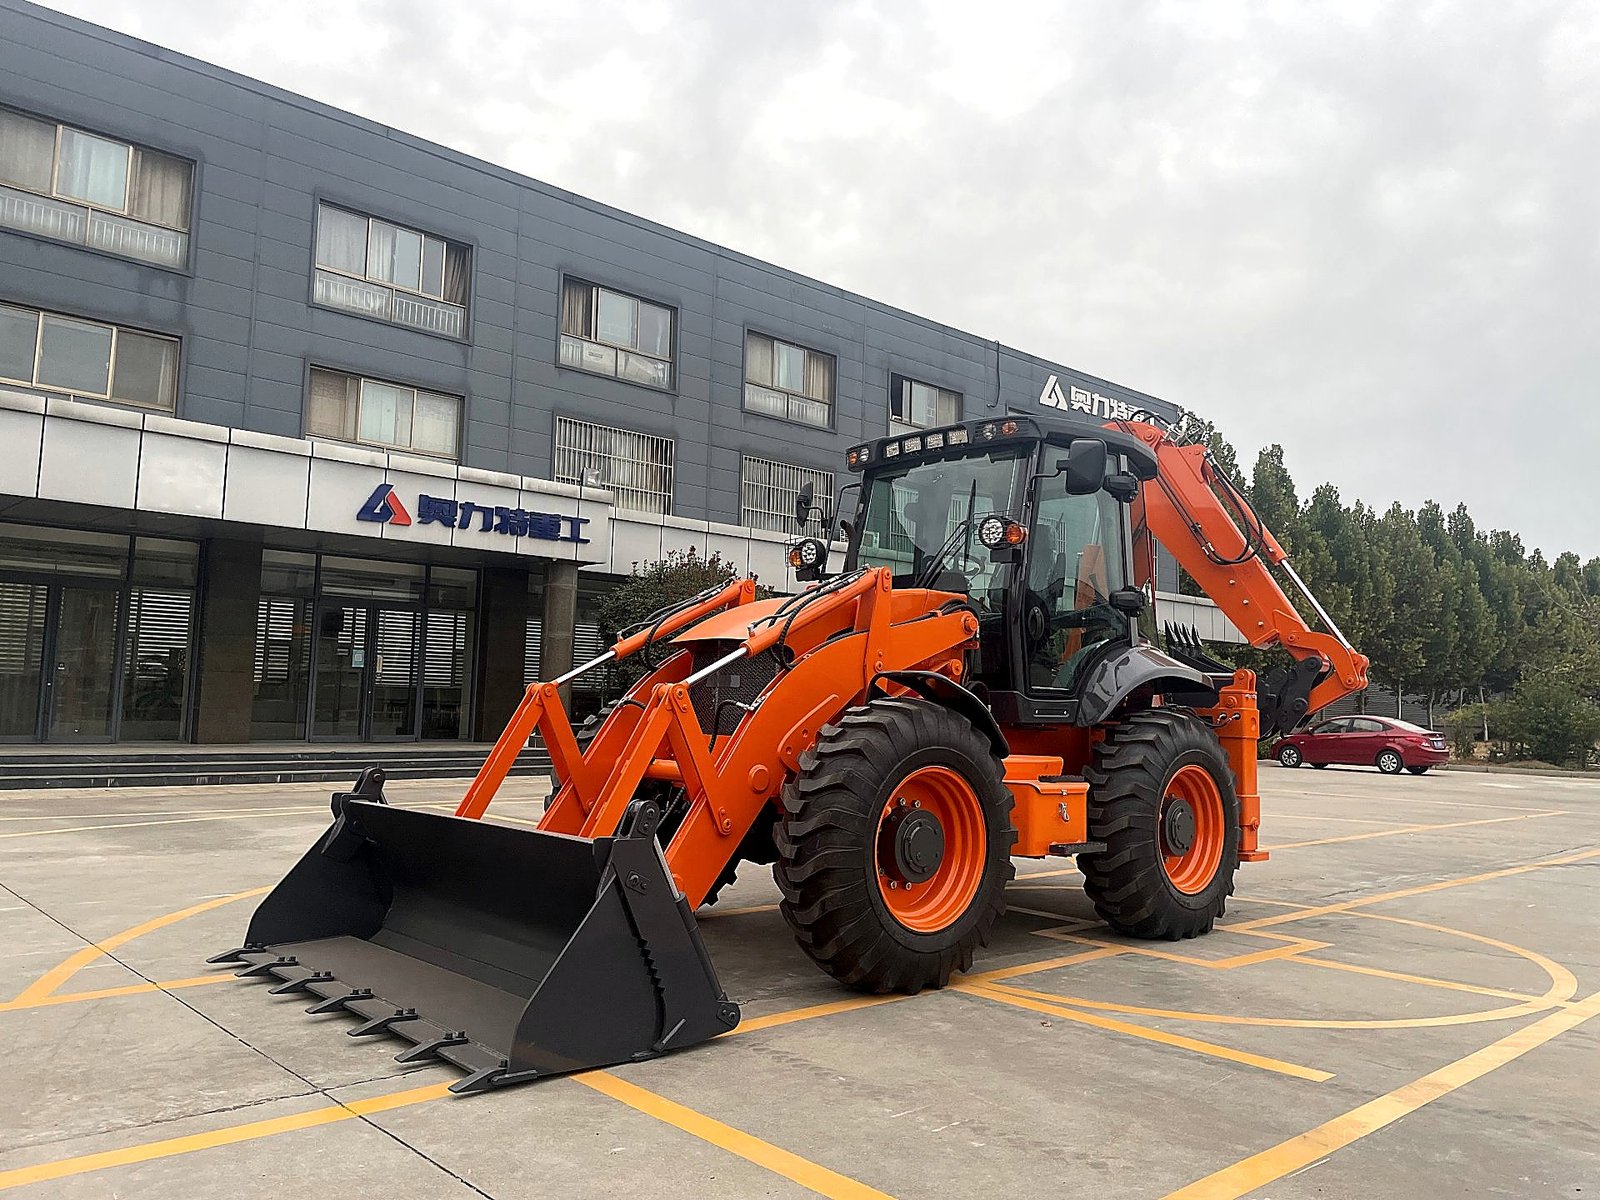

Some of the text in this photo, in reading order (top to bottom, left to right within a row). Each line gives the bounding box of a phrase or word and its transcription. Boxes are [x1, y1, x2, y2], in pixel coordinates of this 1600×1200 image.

[417, 494, 590, 544] 奥力特重工
